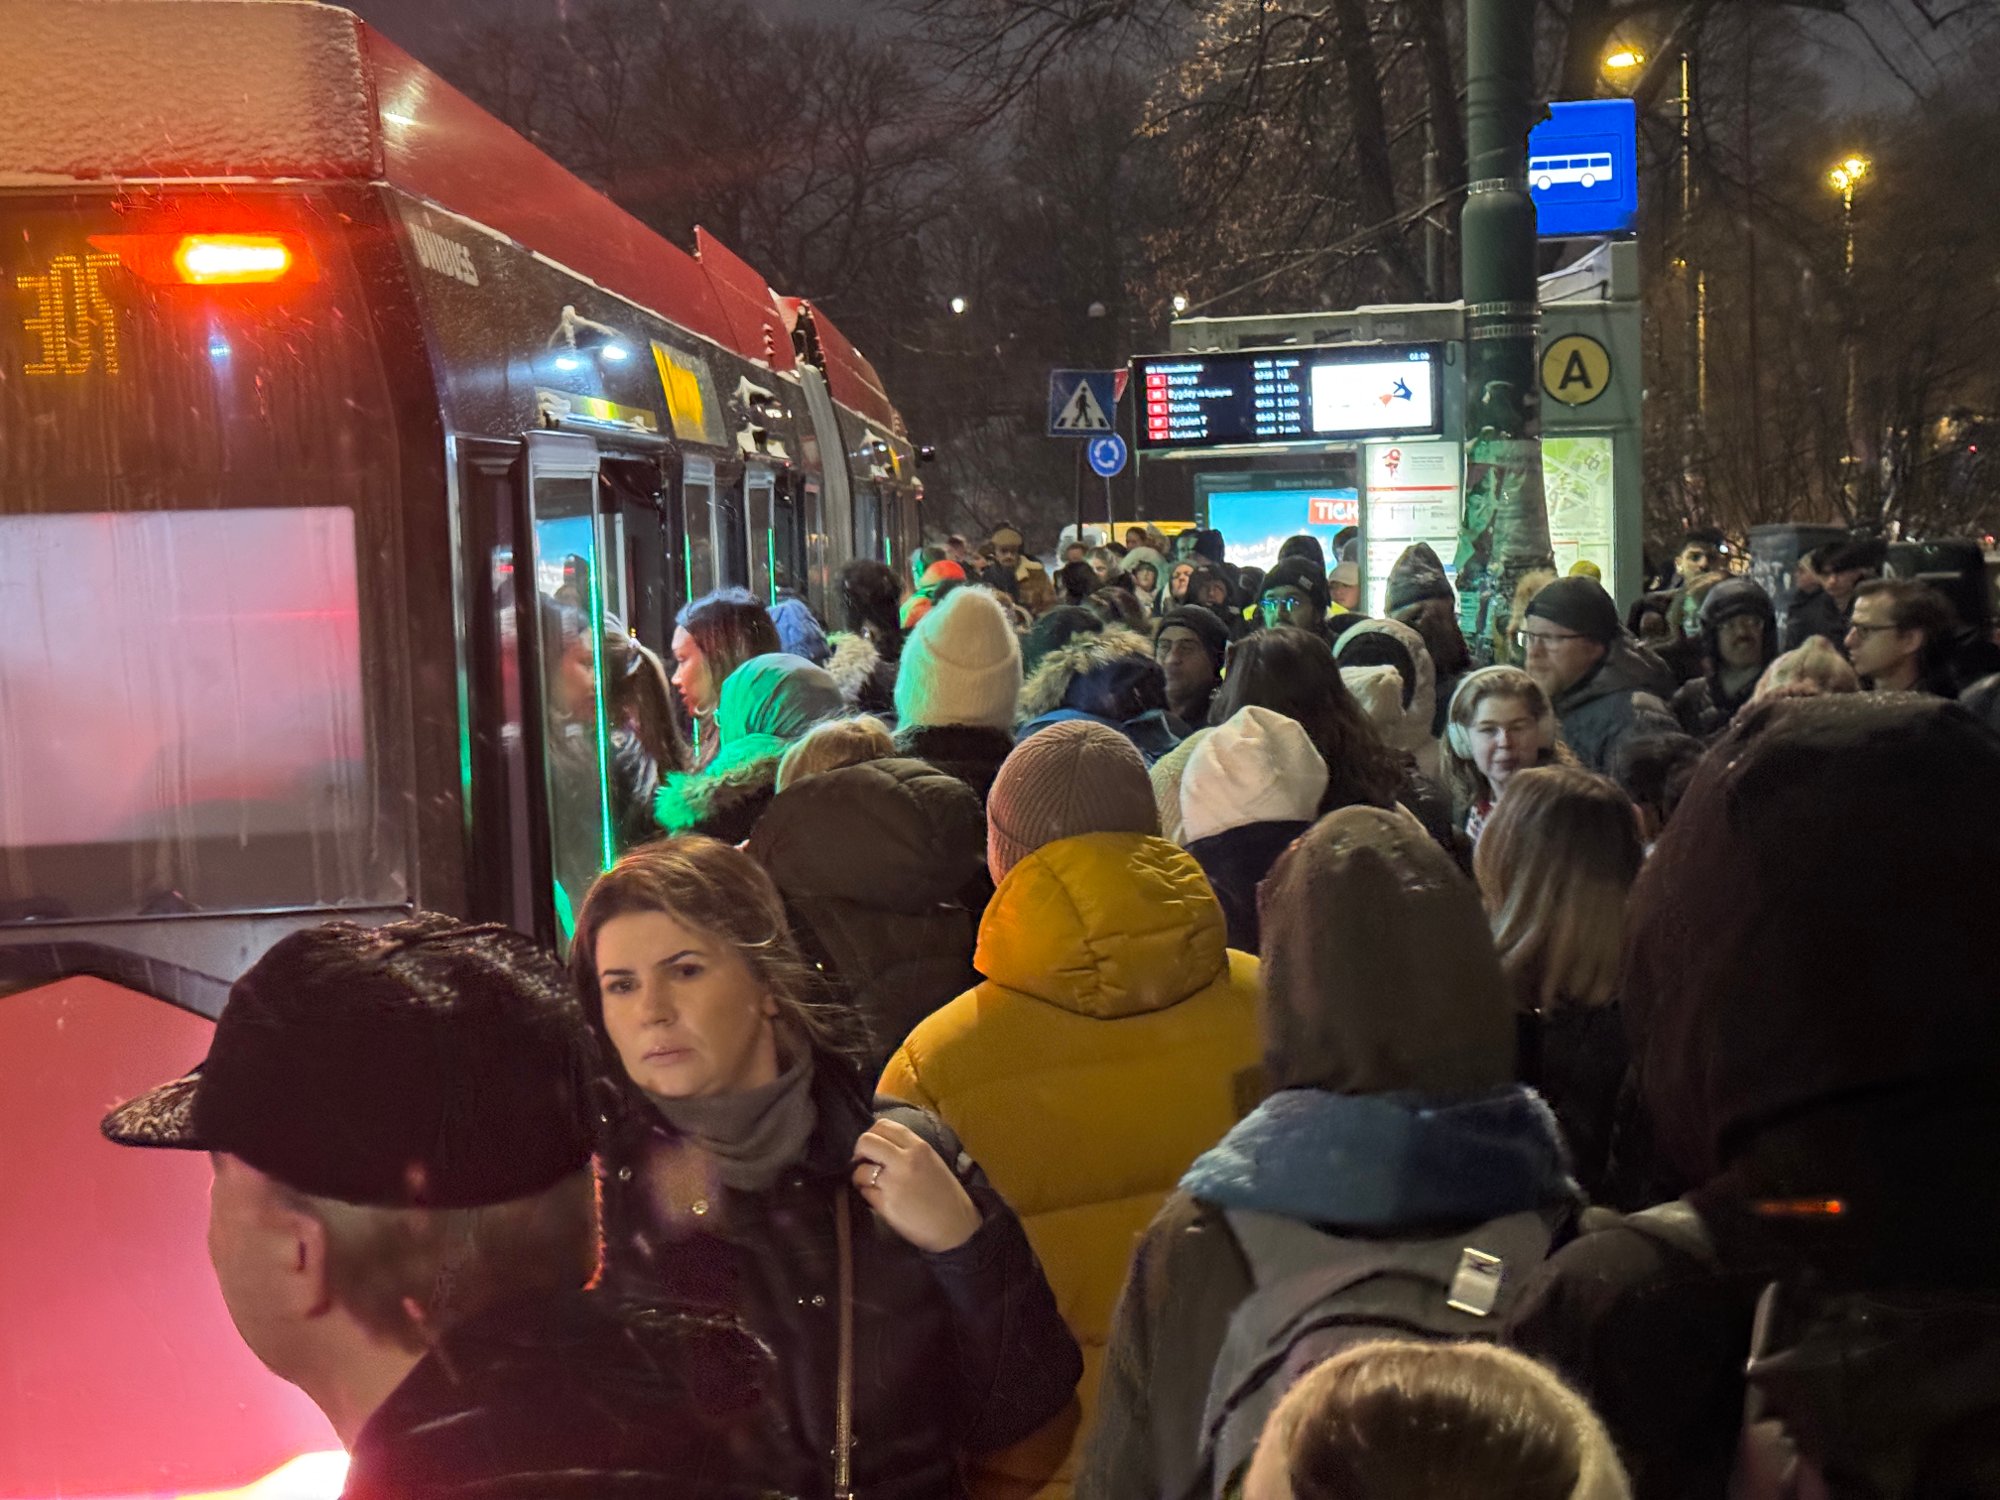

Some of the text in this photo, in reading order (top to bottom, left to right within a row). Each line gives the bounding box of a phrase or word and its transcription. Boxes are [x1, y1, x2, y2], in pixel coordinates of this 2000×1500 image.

[1558, 350, 1593, 389] A
[1283, 382, 1300, 393] min
[1284, 396, 1300, 407] min
[1284, 410, 1301, 421] min
